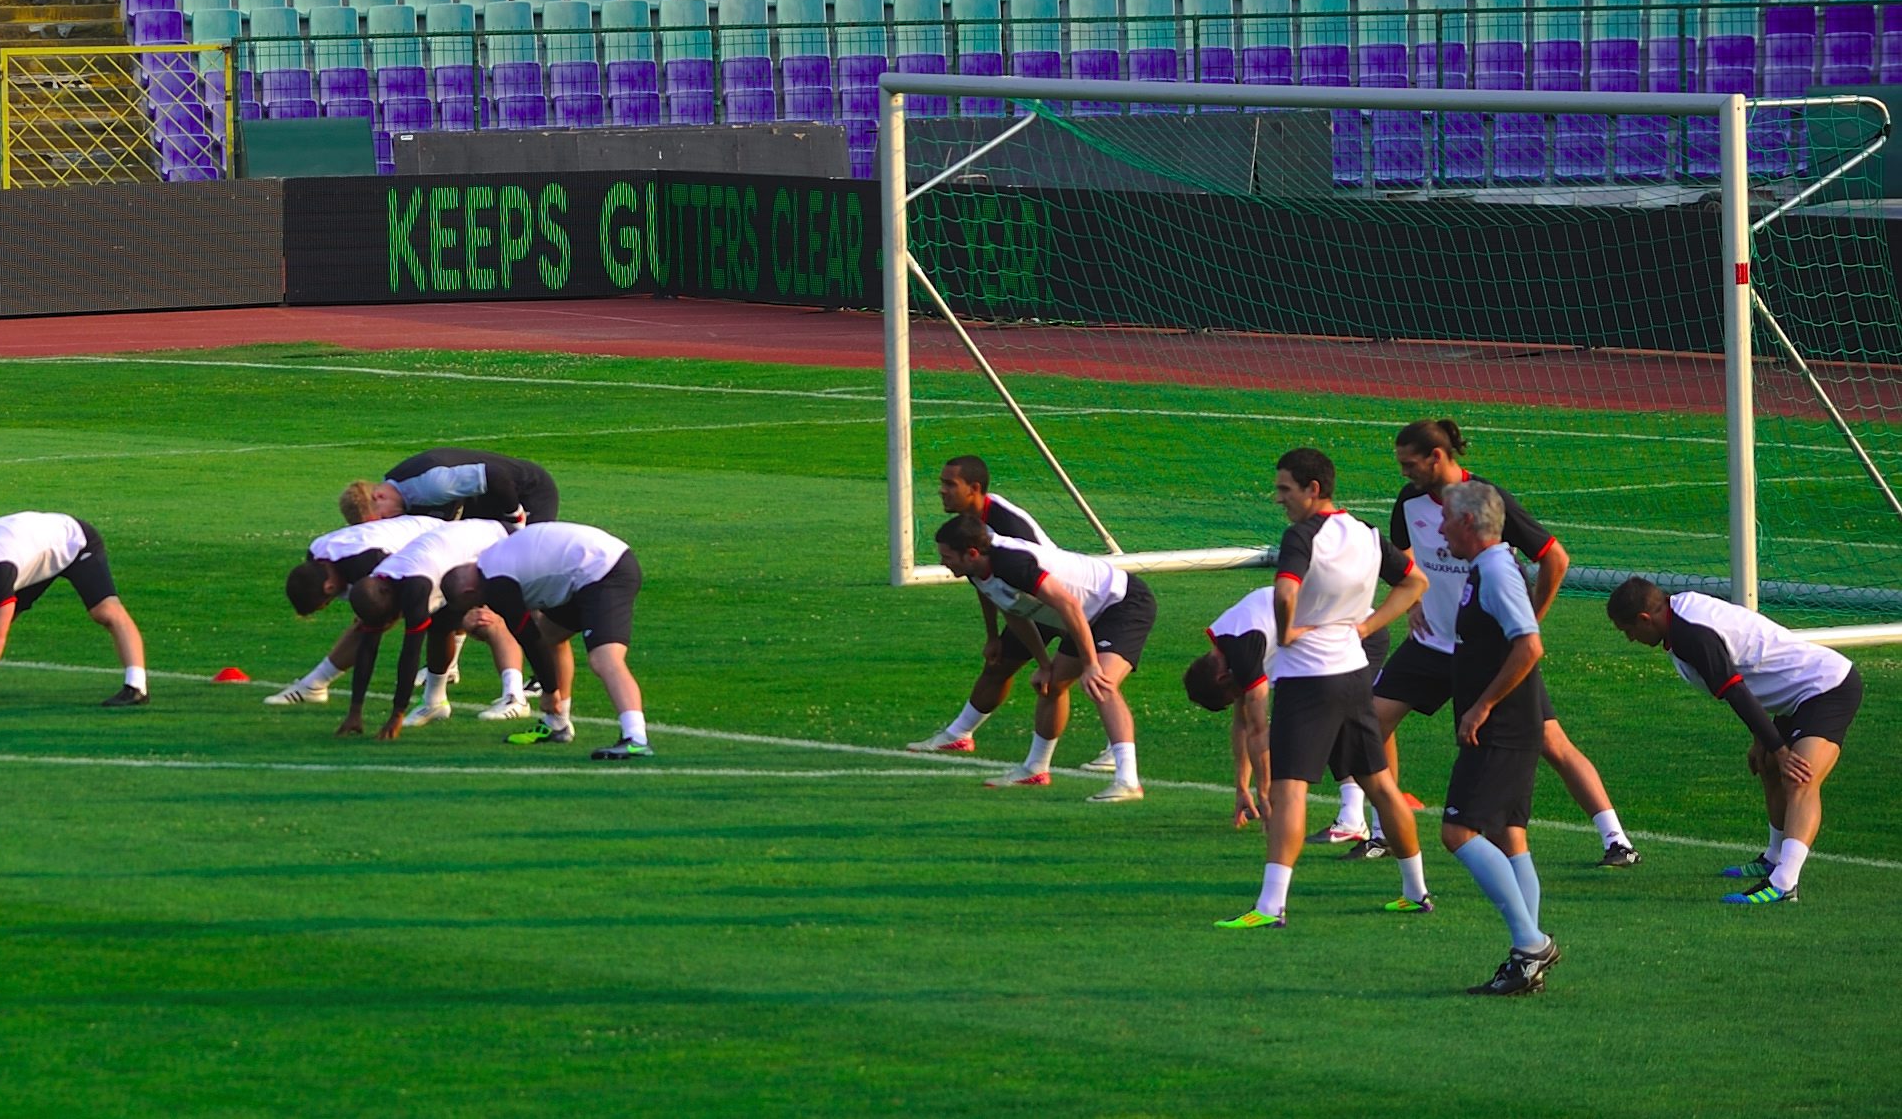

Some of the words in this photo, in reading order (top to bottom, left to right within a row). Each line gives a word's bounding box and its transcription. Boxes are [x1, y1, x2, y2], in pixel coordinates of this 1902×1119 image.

[387, 182, 571, 293] KEEPS
[599, 181, 760, 294] GUTTERS
[772, 187, 865, 298] CLEAR
